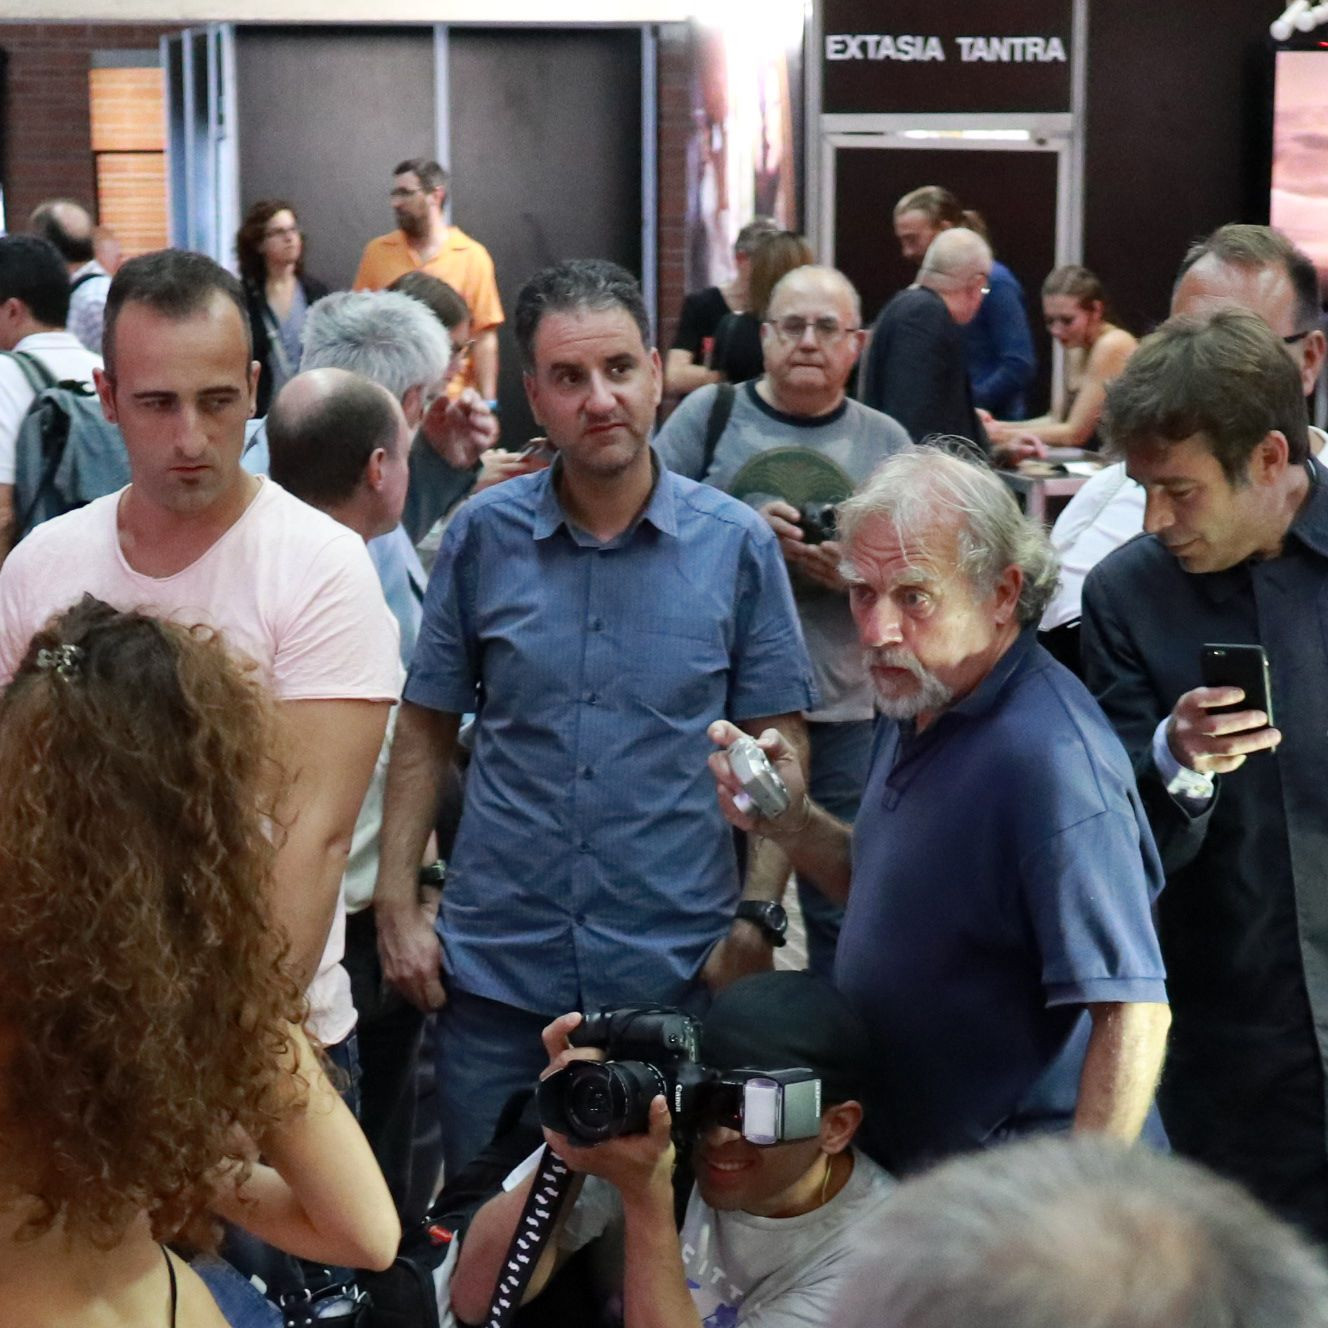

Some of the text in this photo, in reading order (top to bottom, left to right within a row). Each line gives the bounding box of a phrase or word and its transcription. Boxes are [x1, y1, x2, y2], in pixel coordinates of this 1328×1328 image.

[826, 35, 1066, 62] EXTASIA TANTRA
[675, 1084, 683, 1112] Canon
